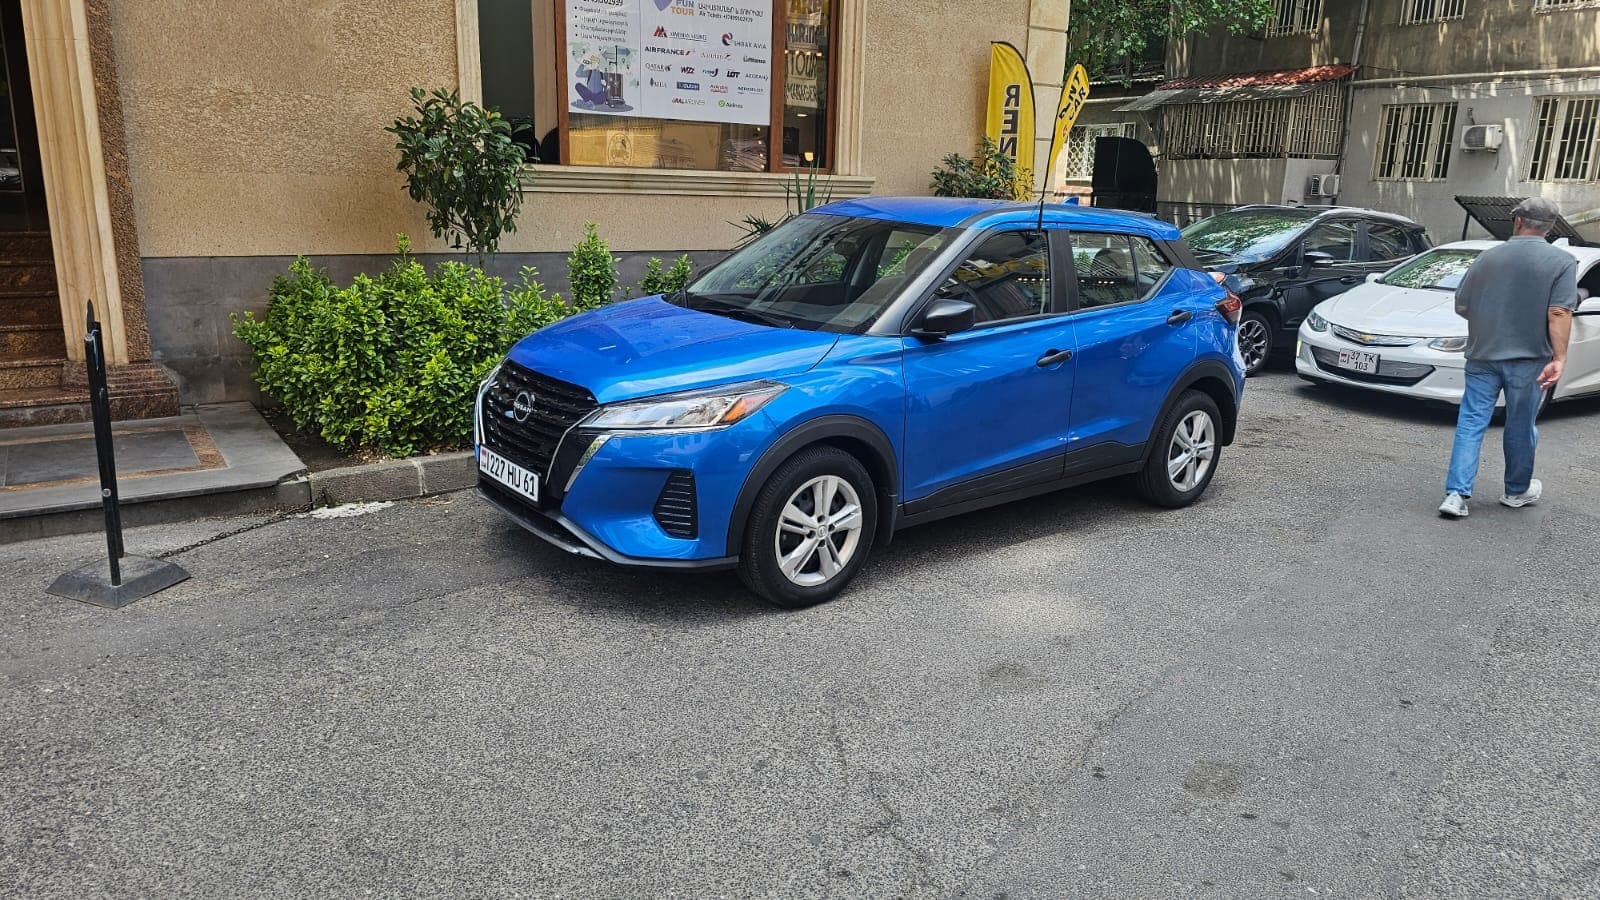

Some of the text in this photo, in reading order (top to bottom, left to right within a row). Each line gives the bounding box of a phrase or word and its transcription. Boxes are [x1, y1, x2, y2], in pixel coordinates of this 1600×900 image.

[671, 6, 695, 16] TOUR
[726, 70, 741, 78] LOT
[1069, 86, 1086, 120] CAR
[1350, 351, 1376, 363] 37 TK
[1354, 361, 1368, 370] 103
[490, 454, 535, 497] 227 HU 61
